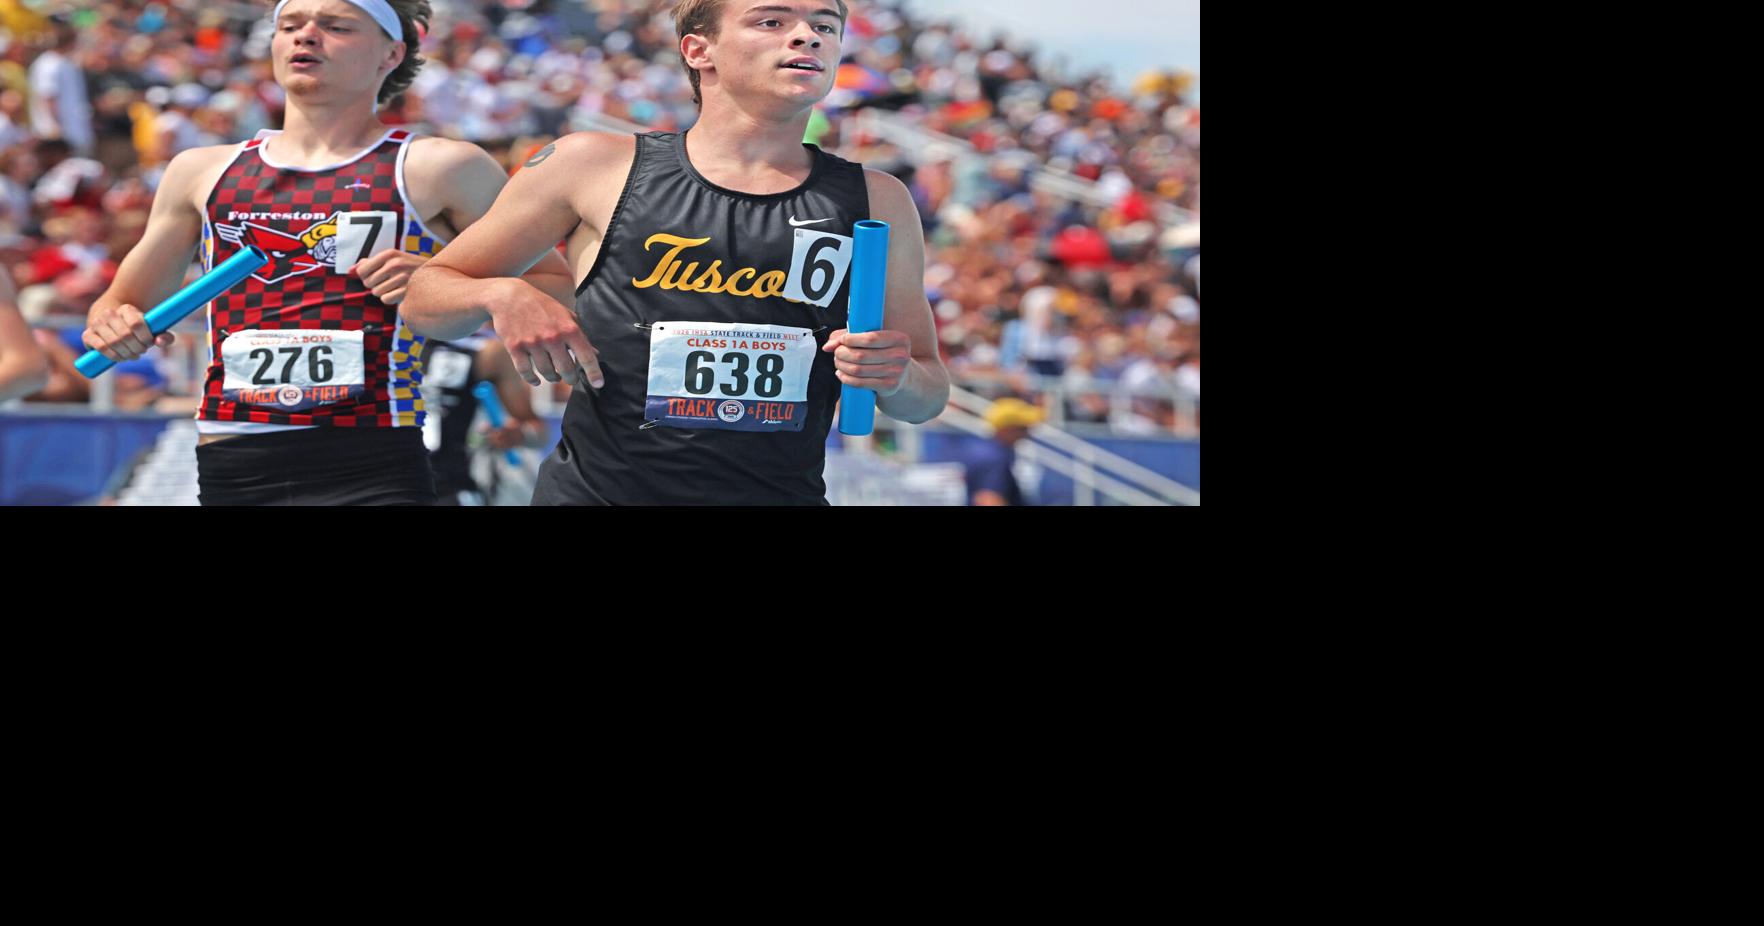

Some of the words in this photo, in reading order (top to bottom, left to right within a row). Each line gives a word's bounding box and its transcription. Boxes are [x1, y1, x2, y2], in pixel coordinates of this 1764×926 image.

[228, 211, 326, 221] Forreston
[349, 216, 383, 264] 7
[632, 233, 790, 299] Tusco
[800, 236, 842, 301] 6
[302, 335, 333, 344] BOYS
[687, 338, 727, 348] CLASS
[732, 340, 748, 349] 1A
[752, 341, 786, 351] BOYS
[249, 345, 333, 385] 276
[684, 350, 784, 398] 638
[239, 387, 279, 403] TRACK
[311, 386, 349, 401] FIELD
[667, 398, 716, 417] TRACK
[747, 406, 754, 415] &
[755, 402, 795, 420] FIELD
[725, 405, 738, 413] 125
